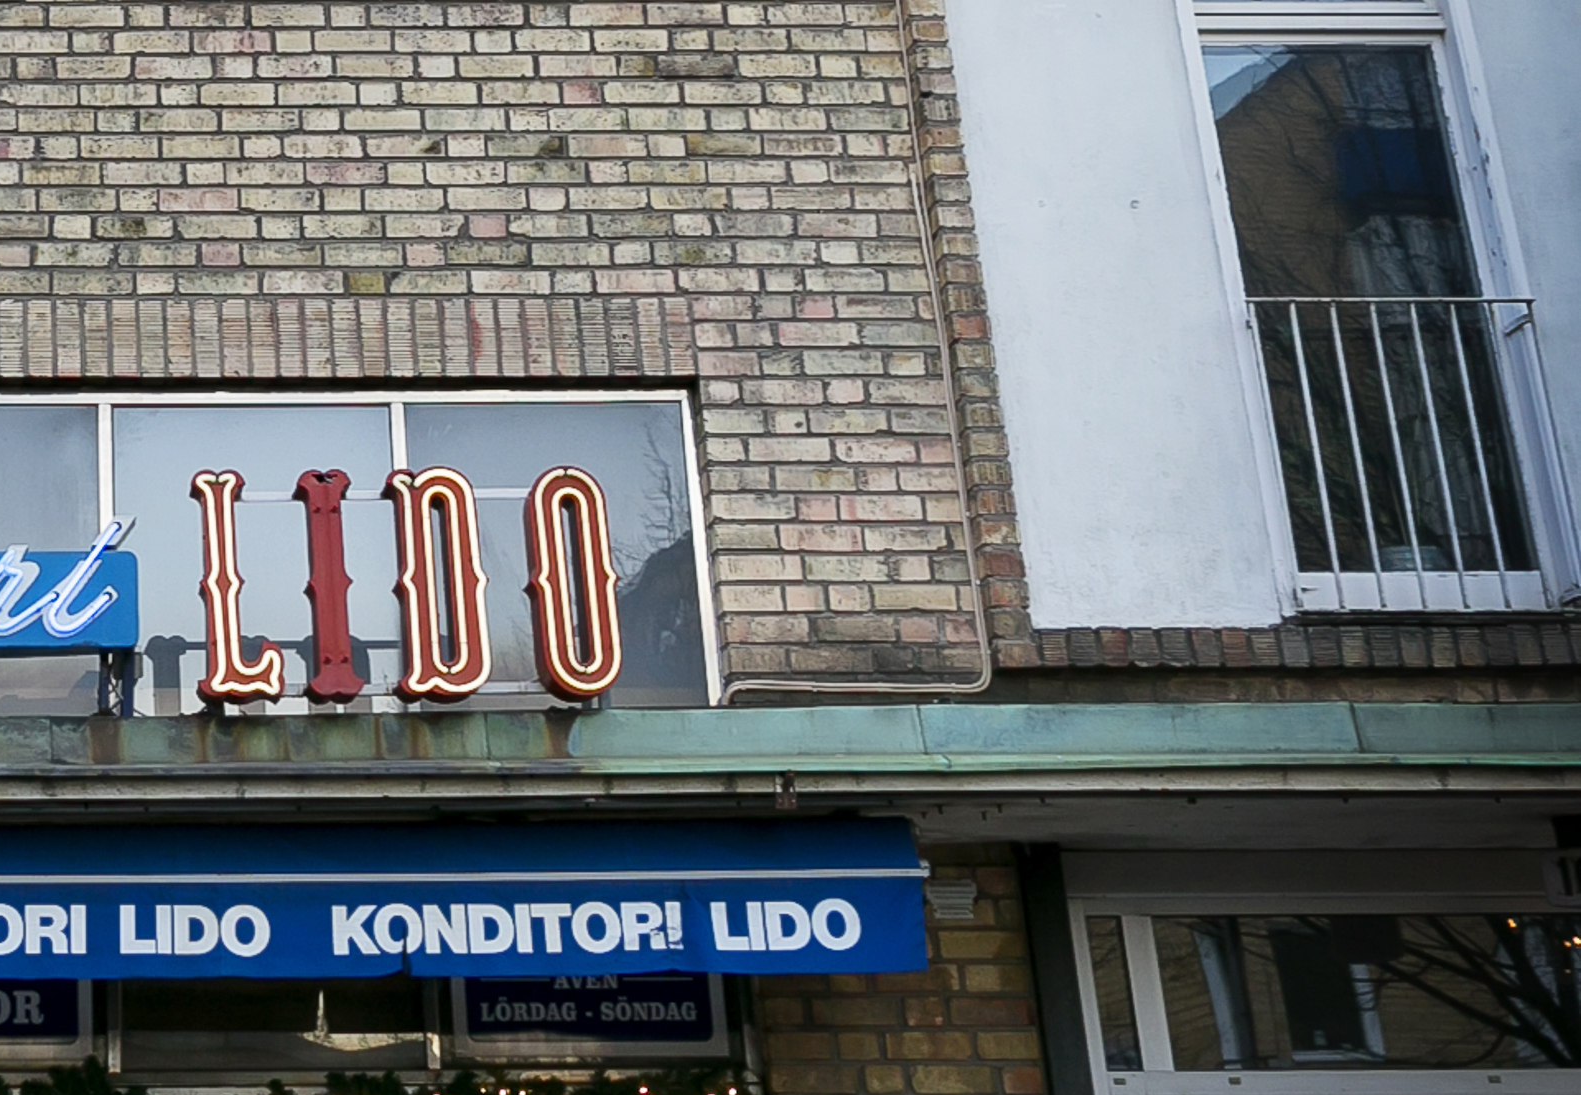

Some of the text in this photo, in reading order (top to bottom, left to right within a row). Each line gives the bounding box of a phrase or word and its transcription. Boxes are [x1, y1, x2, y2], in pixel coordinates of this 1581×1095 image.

[189, 466, 621, 704] LIDO
[120, 905, 270, 956] LIDO
[332, 899, 860, 955] KONDITORI LIDO
[480, 996, 577, 1022] LÖRDAG
[600, 996, 697, 1023] SÖNDAG
